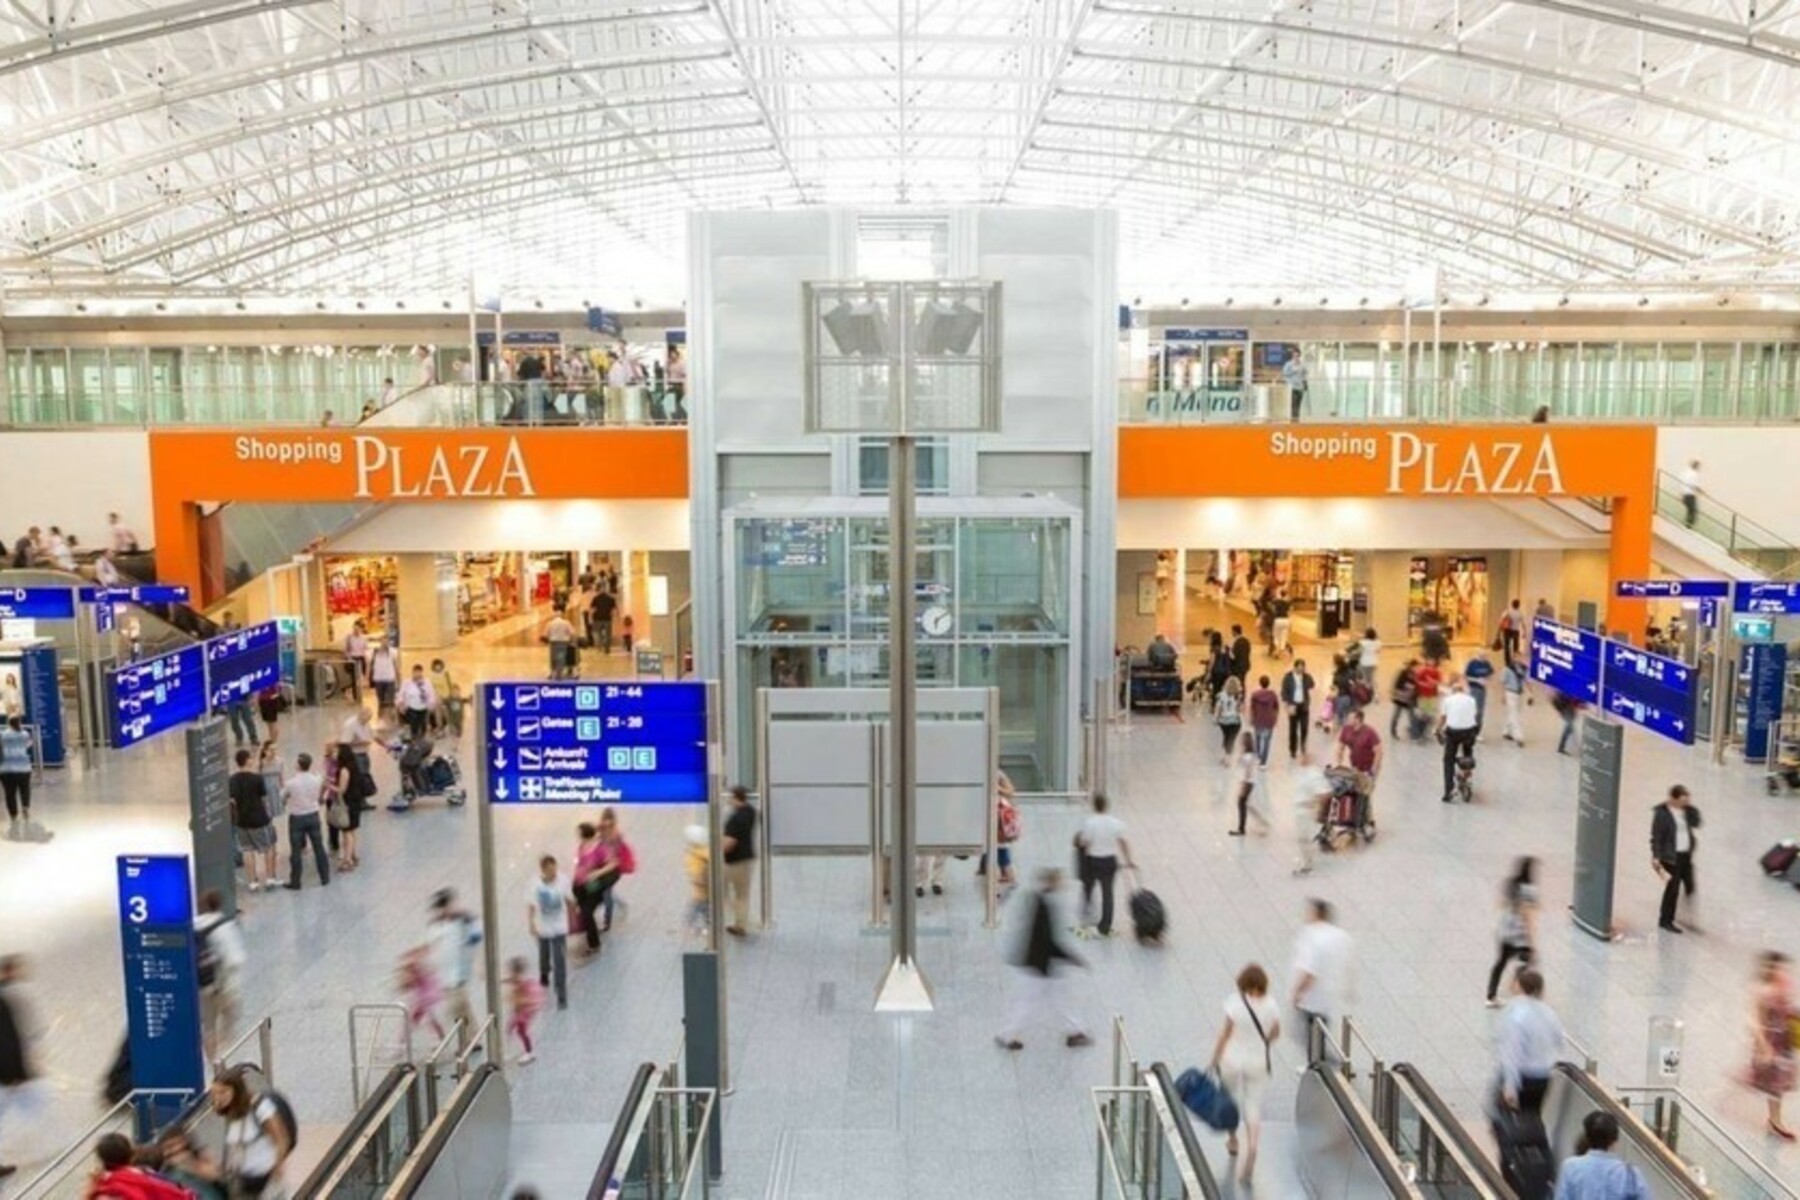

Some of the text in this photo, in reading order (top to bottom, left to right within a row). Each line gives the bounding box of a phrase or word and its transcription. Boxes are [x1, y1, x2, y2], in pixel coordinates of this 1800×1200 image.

[235, 435, 536, 498] Shopping PLAZA
[1270, 431, 1566, 494] Shopping PLAZA
[129, 896, 148, 923] 3
